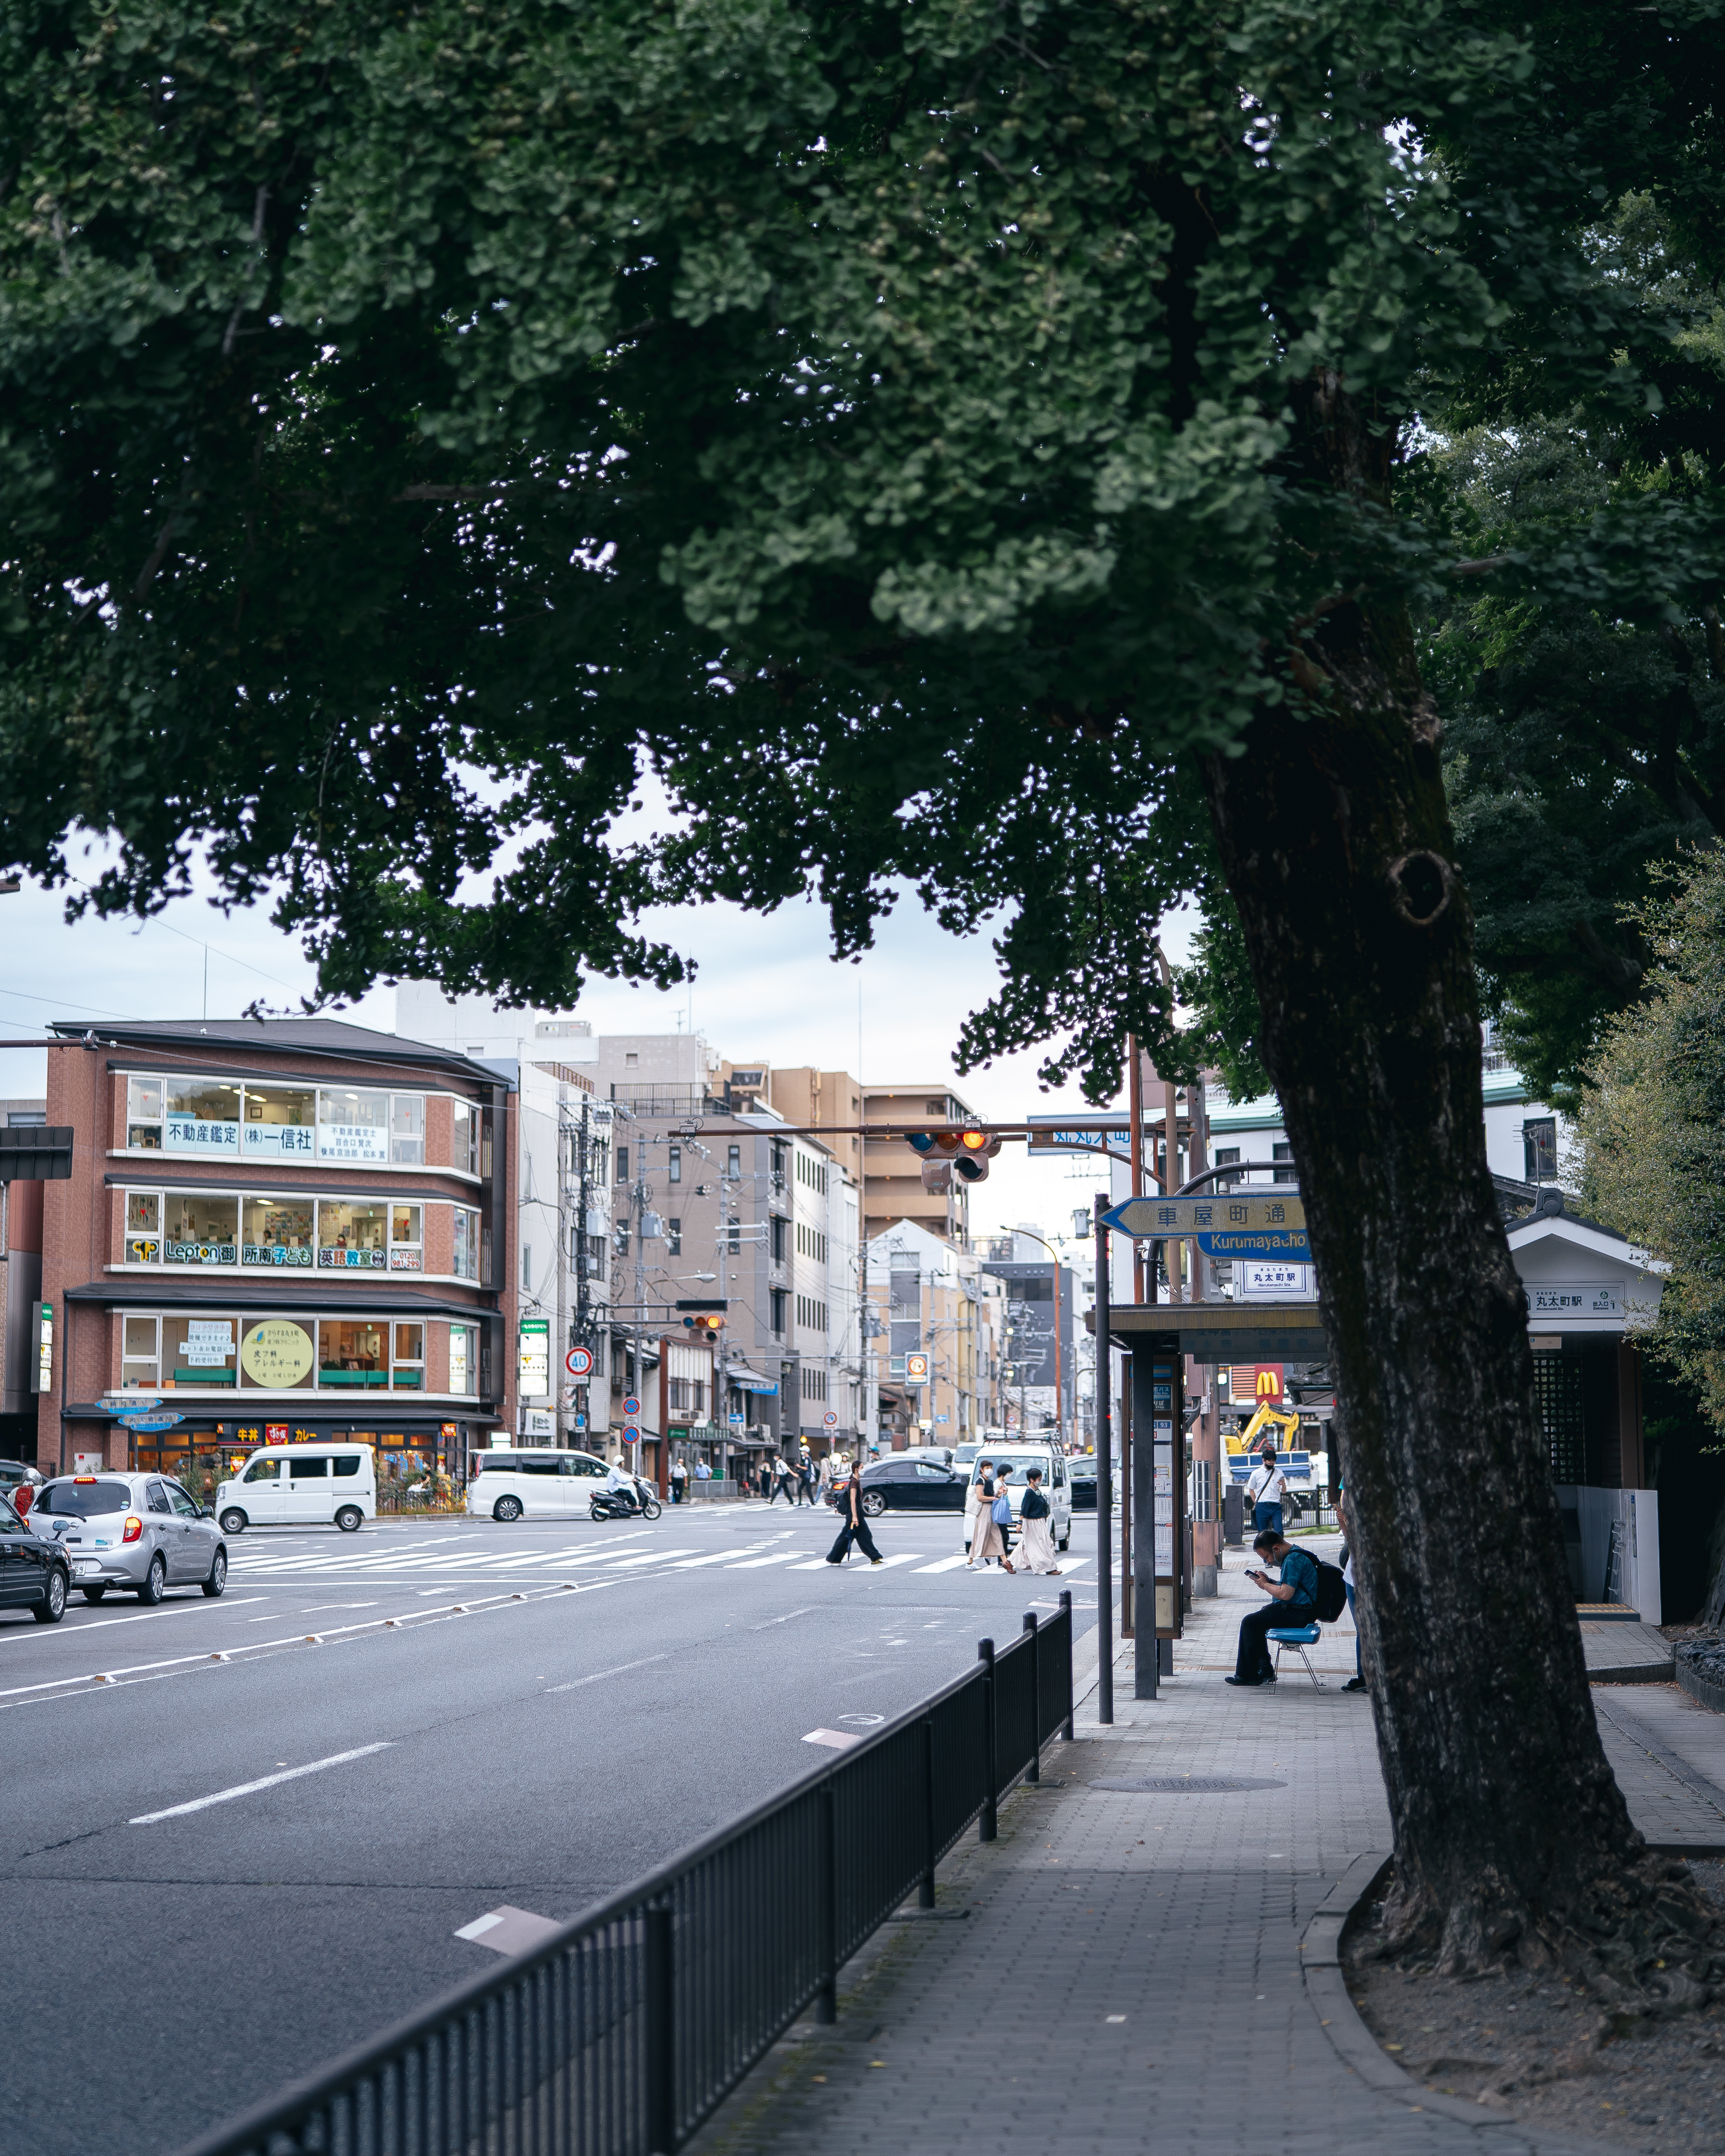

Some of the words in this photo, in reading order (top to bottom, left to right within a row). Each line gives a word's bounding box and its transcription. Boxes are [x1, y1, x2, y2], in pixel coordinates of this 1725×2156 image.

[169, 1123, 236, 1144] 不動産鑑定
[244, 1127, 312, 1150] (株)一信社
[1157, 1204, 1286, 1226] 車屋町通
[167, 1241, 218, 1262] Lepton
[1254, 1273, 1295, 1281] 丸太町駅
[1537, 1296, 1582, 1306] 丸太町駅
[254, 1359, 300, 1368] アレルギー科
[572, 1355, 586, 1367] 40
[238, 1428, 259, 1442] 牛丼
[295, 1429, 317, 1442] カレー
